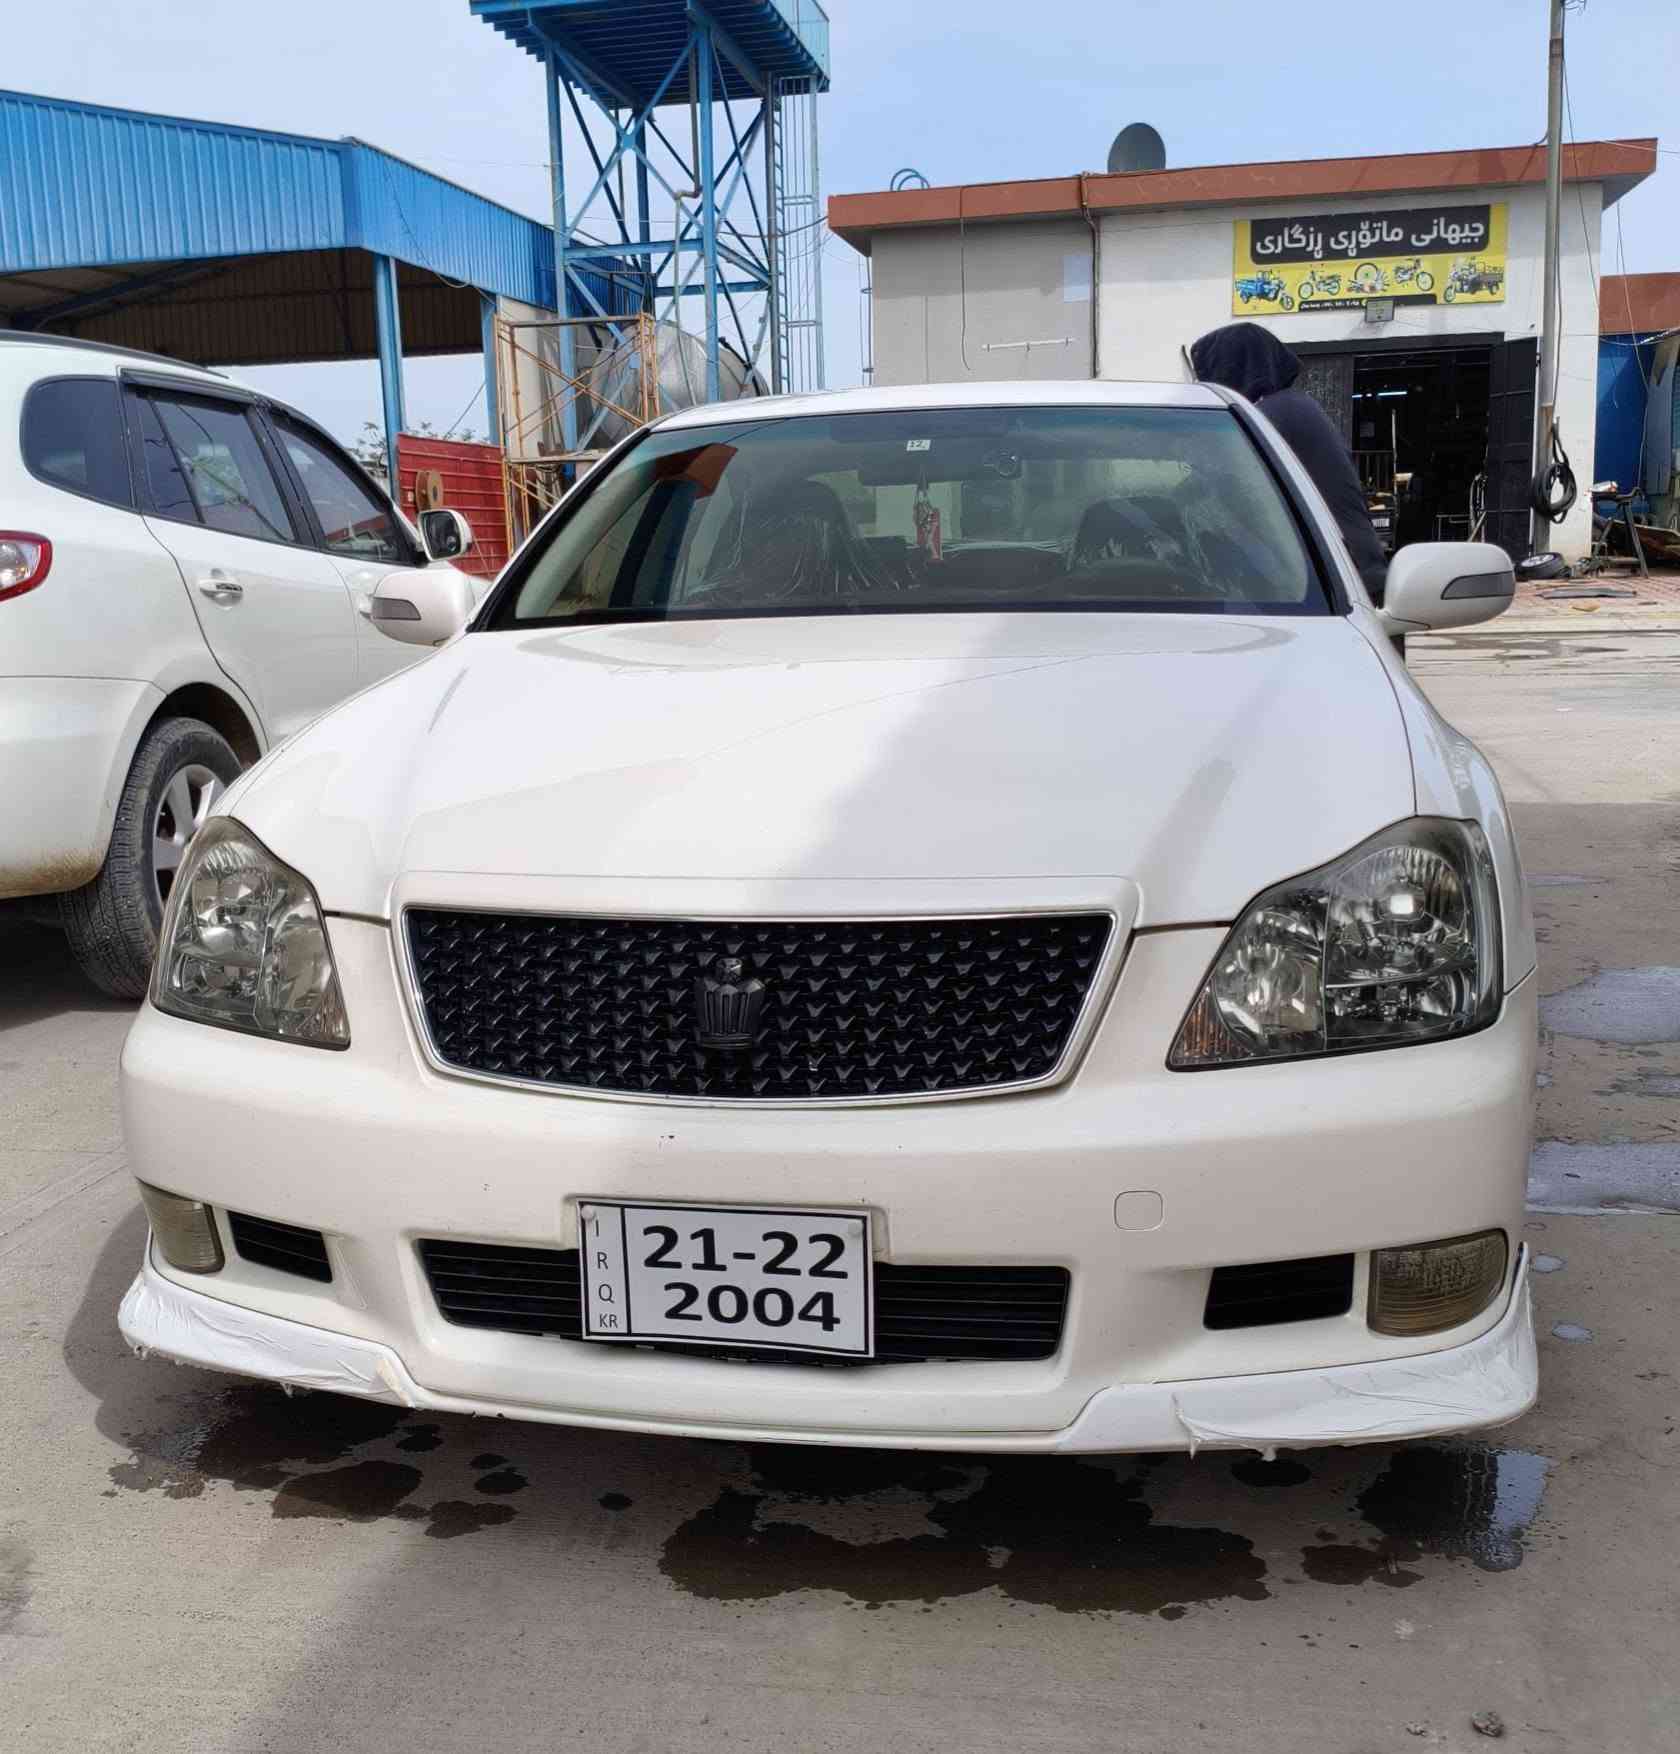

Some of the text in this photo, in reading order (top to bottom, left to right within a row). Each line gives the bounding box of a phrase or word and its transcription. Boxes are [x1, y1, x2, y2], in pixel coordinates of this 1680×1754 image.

[1410, 216, 1485, 247] جیهانی
[642, 1225, 849, 1279] 21-22
[599, 1313, 618, 1329] KR
[663, 1282, 841, 1332] 2004
